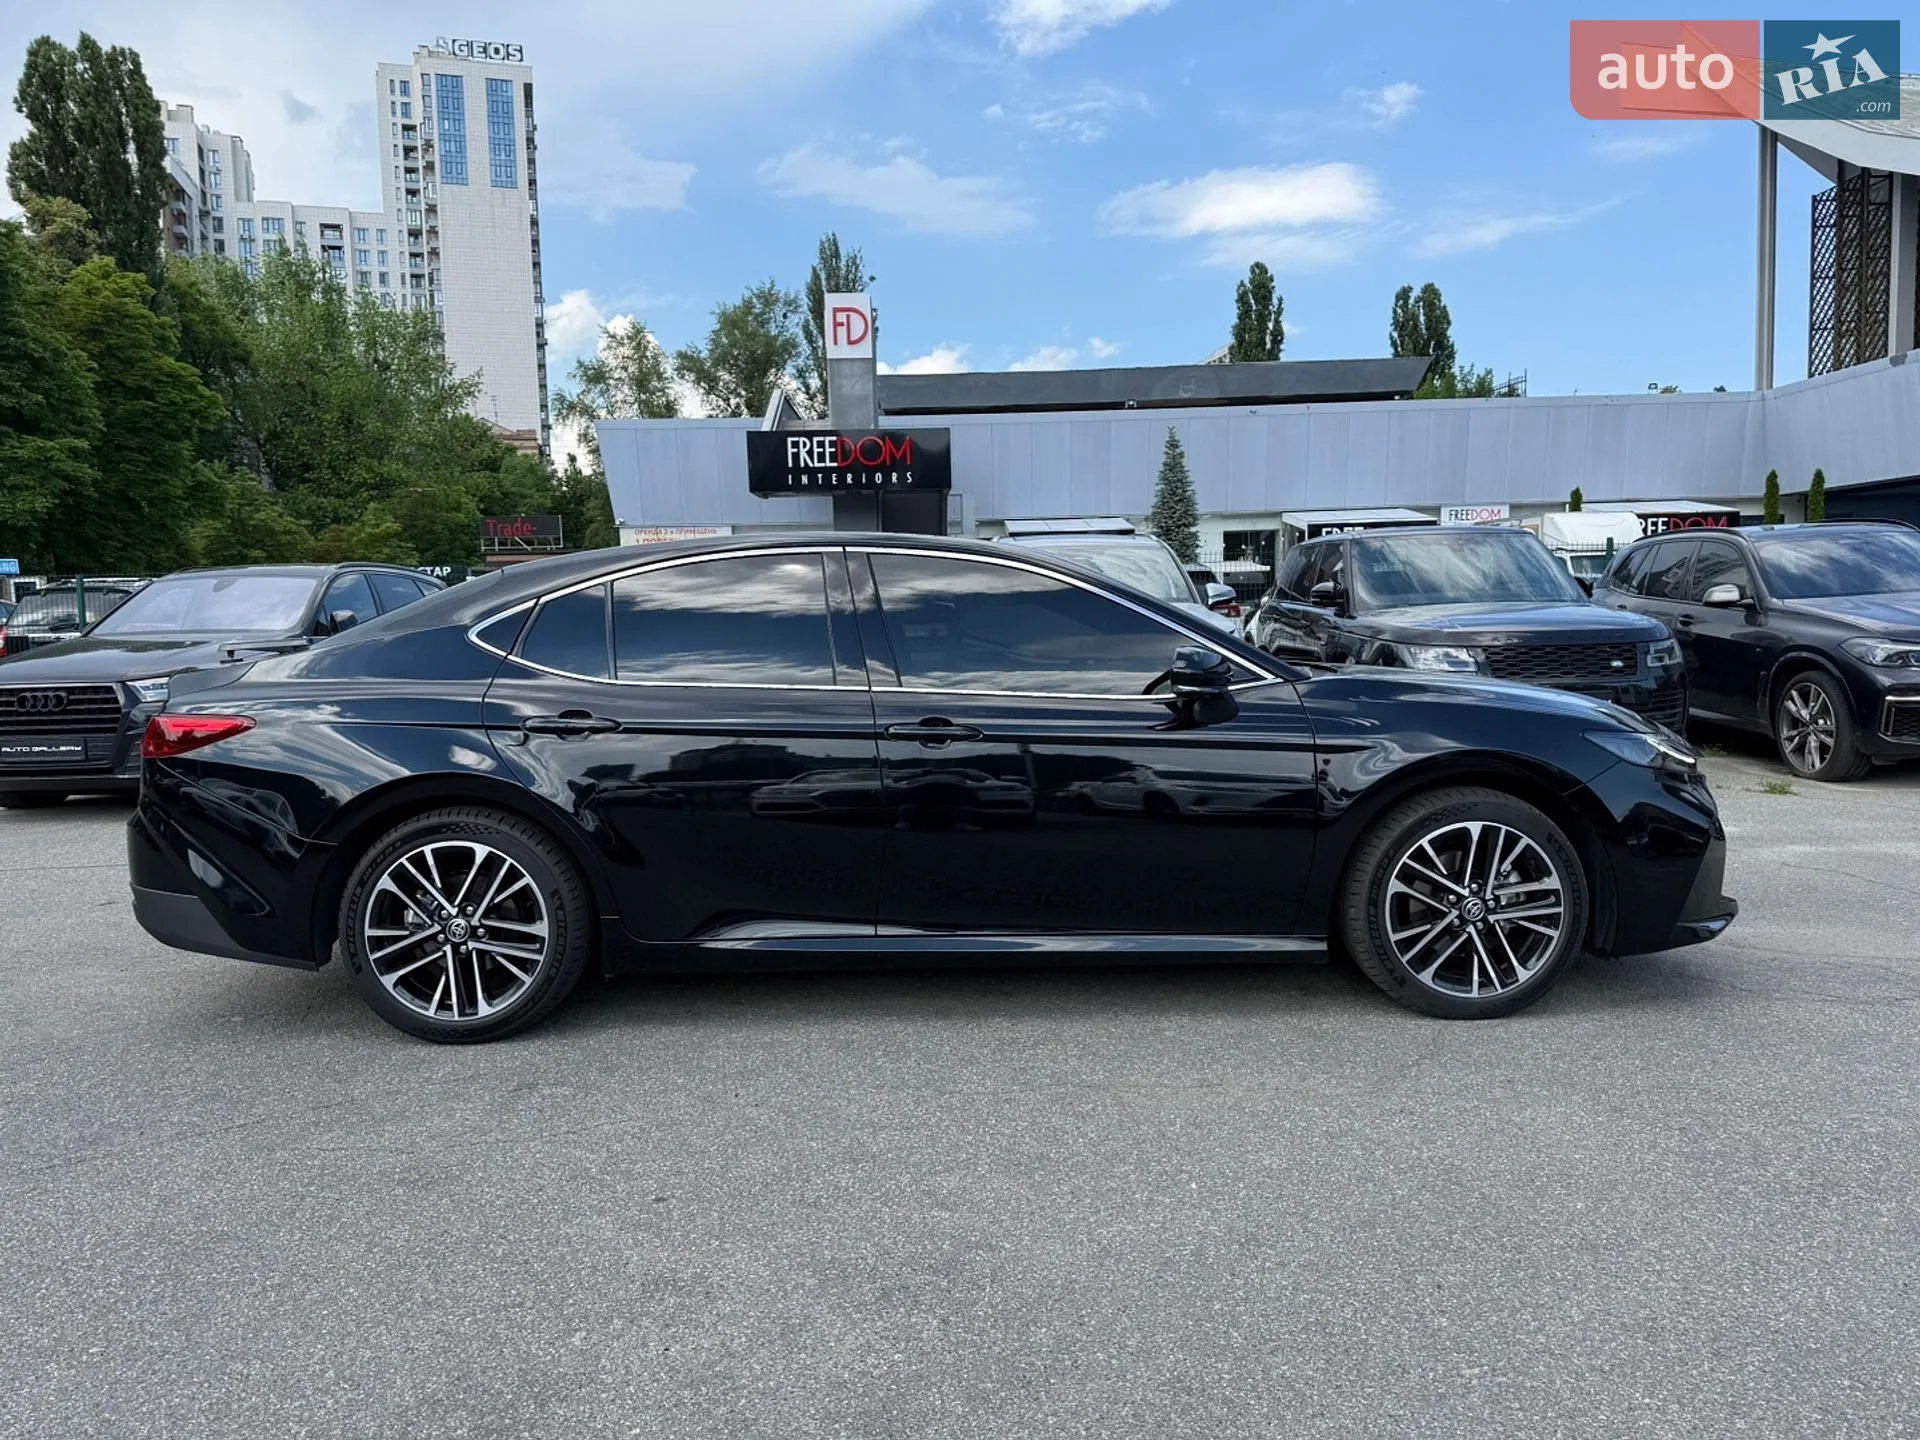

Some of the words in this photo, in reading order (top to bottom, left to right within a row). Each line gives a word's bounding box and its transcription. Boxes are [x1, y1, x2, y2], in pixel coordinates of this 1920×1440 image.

[452, 38, 523, 62] GEOS
[832, 306, 869, 346] FD
[787, 436, 912, 467] FREEDOM
[788, 472, 913, 485] INTERIORS
[1449, 508, 1501, 521] FREEDOM
